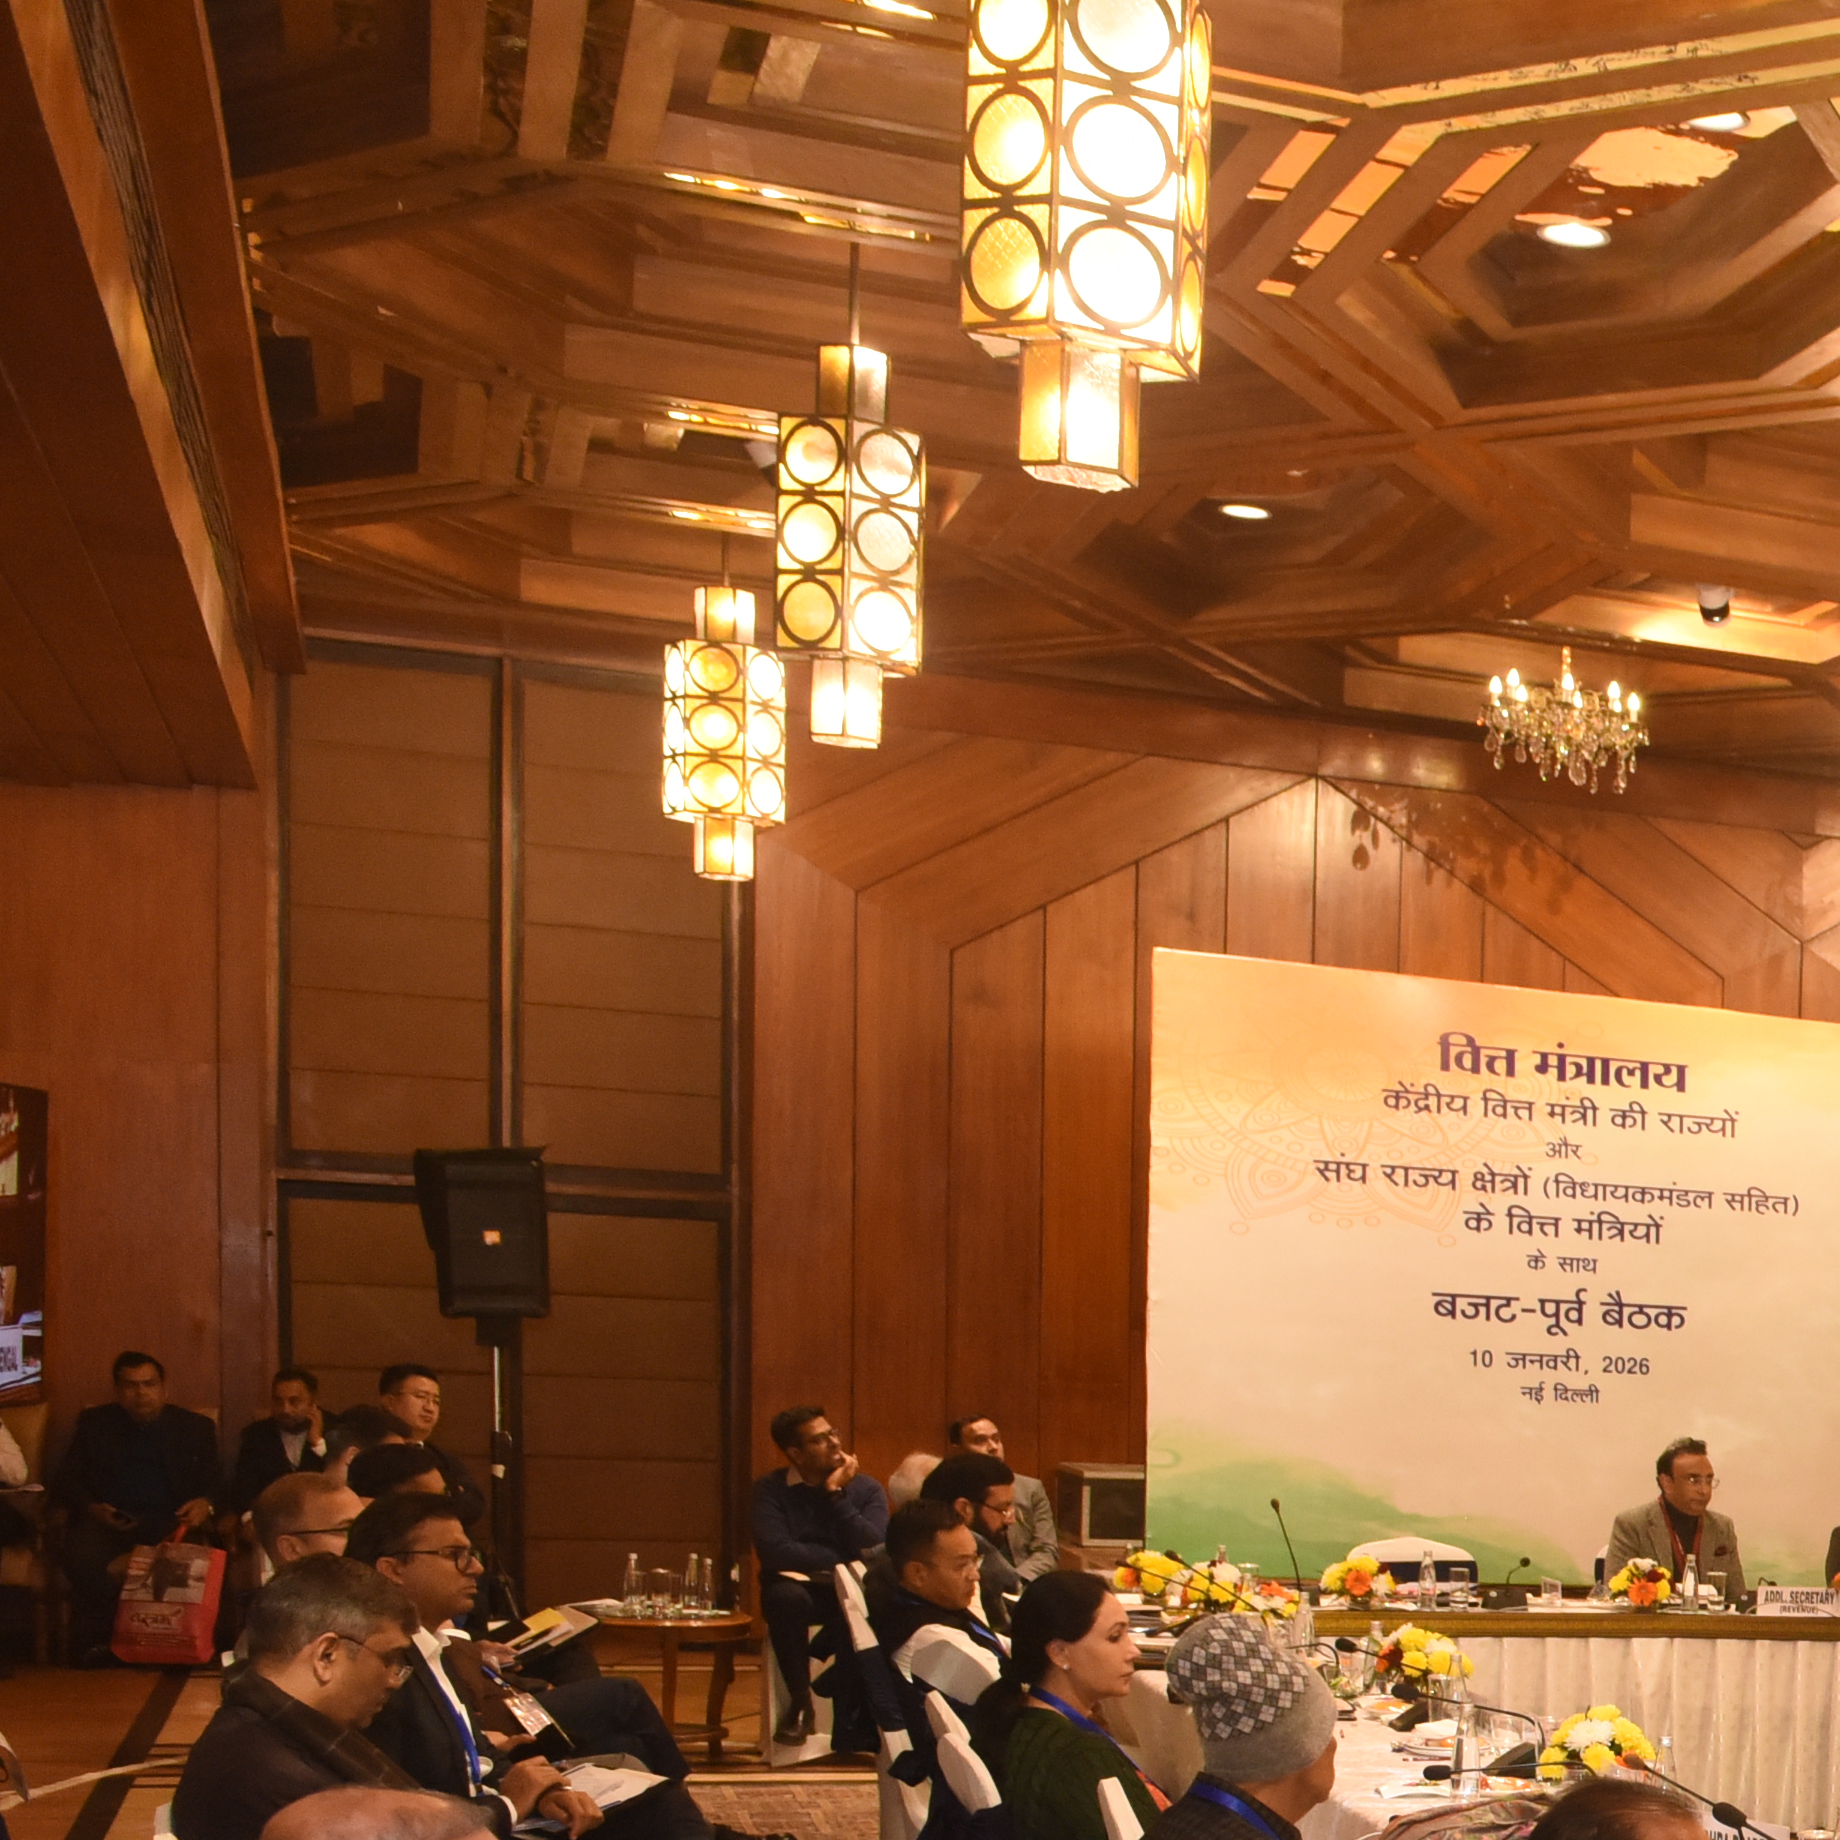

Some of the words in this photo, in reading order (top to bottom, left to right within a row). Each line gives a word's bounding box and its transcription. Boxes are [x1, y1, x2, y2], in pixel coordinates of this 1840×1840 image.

[1437, 1031, 1518, 1078] वित्त
[1531, 1041, 1688, 1093] मंत्रालय
[1381, 1080, 1471, 1117] केंद्रीय
[1480, 1088, 1536, 1122] वित्त
[1545, 1096, 1600, 1127] मंत्री
[1609, 1100, 1648, 1131] की
[1657, 1108, 1739, 1139] राज्यों
[1545, 1135, 1583, 1160] और
[1312, 1152, 1370, 1185] संघ
[1380, 1164, 1460, 1192] राज्य
[1471, 1161, 1533, 1197] क्षेत्रों
[1543, 1172, 1715, 1210] (विधायकमंडल
[1722, 1186, 1800, 1217] सहित)
[1462, 1201, 1495, 1234] के
[1505, 1204, 1562, 1239] वित्त
[1571, 1210, 1665, 1245] मंत्रियों
[1526, 1248, 1547, 1271] के
[1556, 1256, 1598, 1275] साथ
[1431, 1287, 1588, 1337] बजट-पूर्व
[1599, 1289, 1688, 1332] बैठक
[1469, 1348, 1494, 1369] 10
[1505, 1347, 1589, 1376] जनवरी,
[1601, 1355, 1650, 1376] 2026
[1520, 1380, 1546, 1405] नई
[1552, 1382, 1600, 1404] दिल्ली
[1790, 1590, 1835, 1605] SECRETARY
